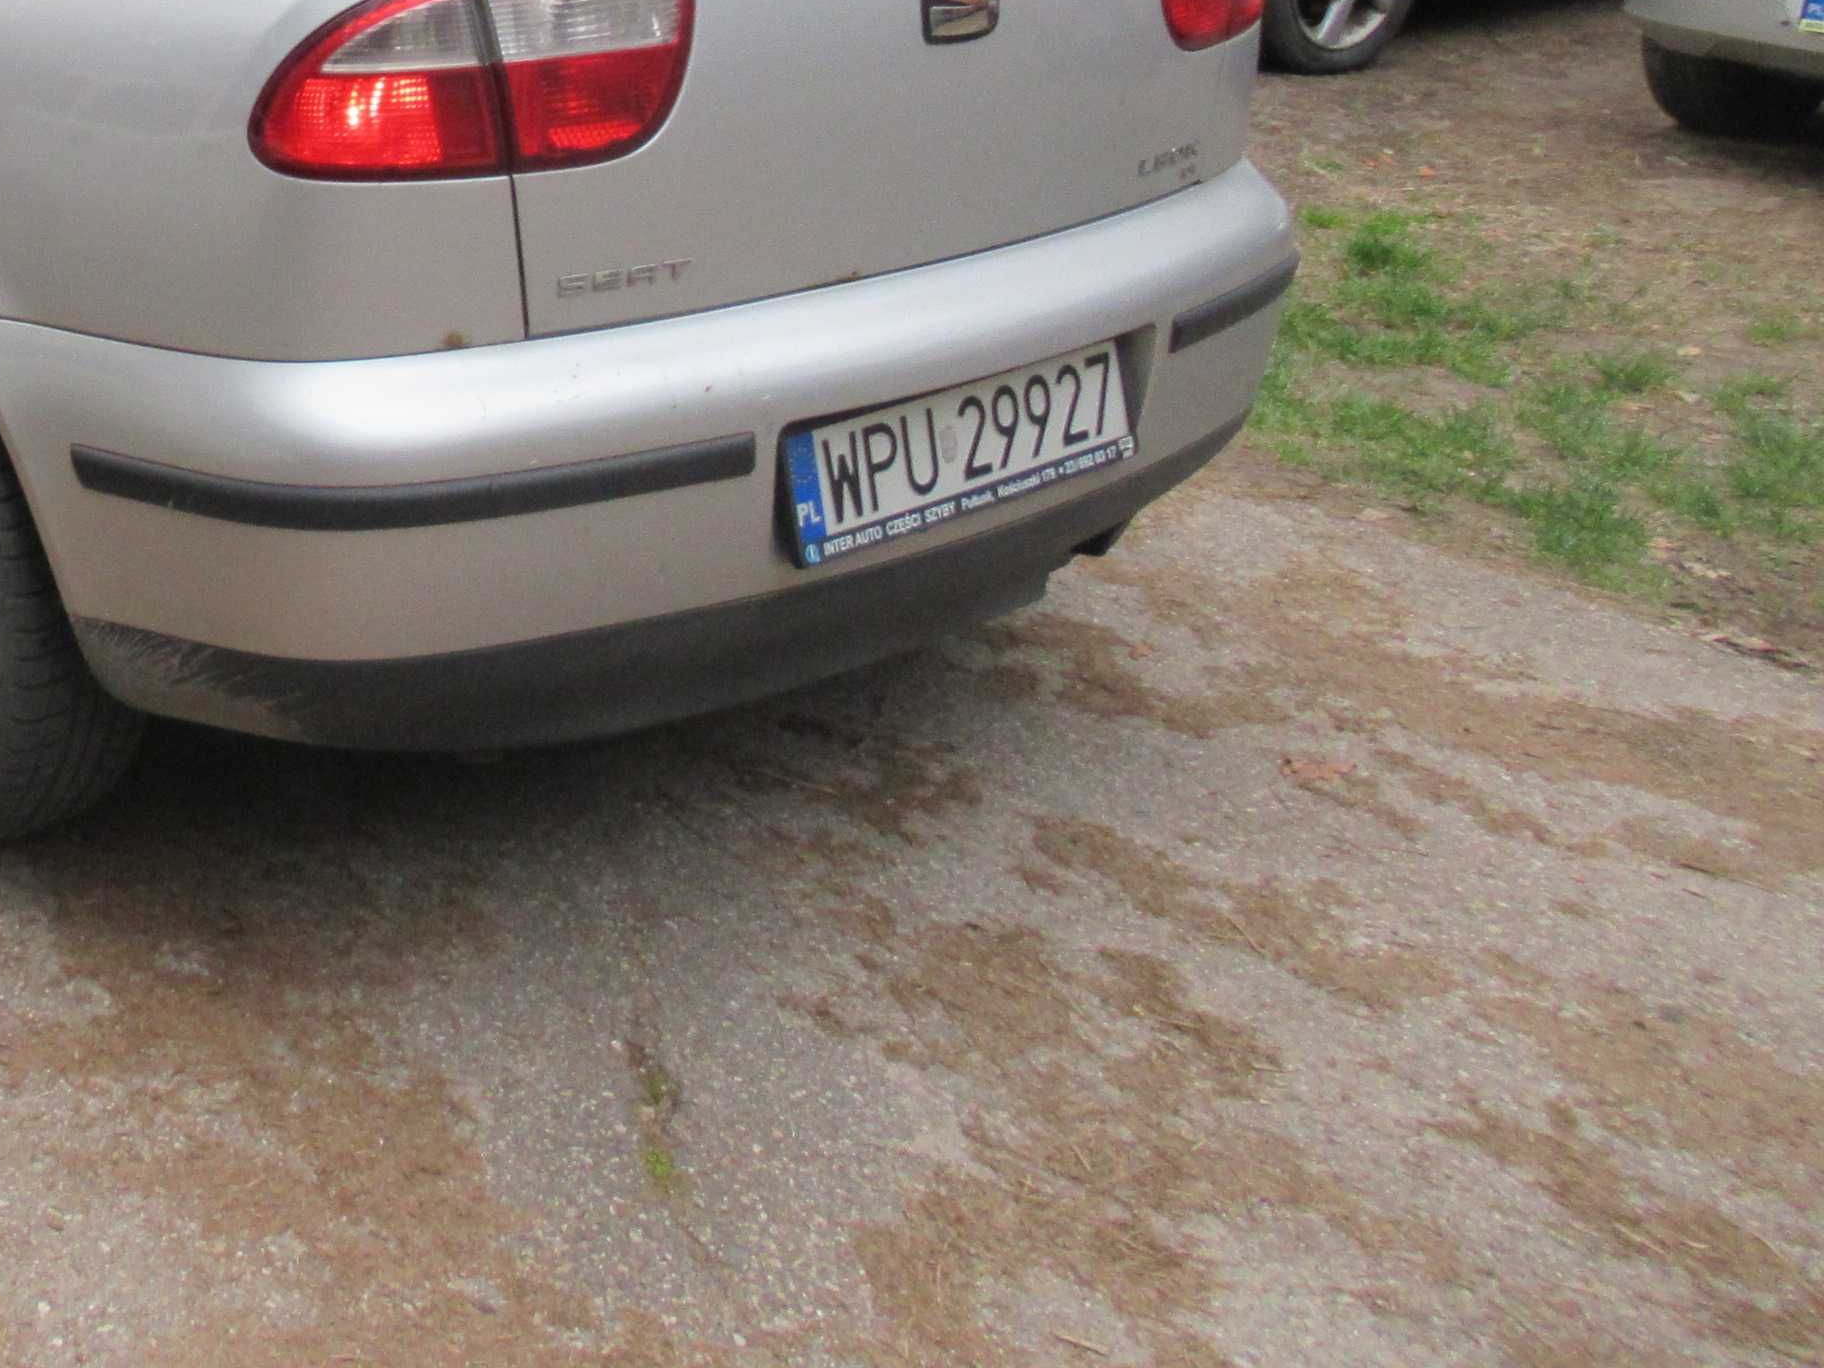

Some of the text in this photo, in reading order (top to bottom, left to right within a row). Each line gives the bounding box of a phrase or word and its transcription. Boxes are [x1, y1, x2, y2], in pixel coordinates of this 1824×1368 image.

[557, 256, 694, 299] SEAT
[822, 351, 1110, 524] WPU 29927
[796, 499, 822, 528] PL
